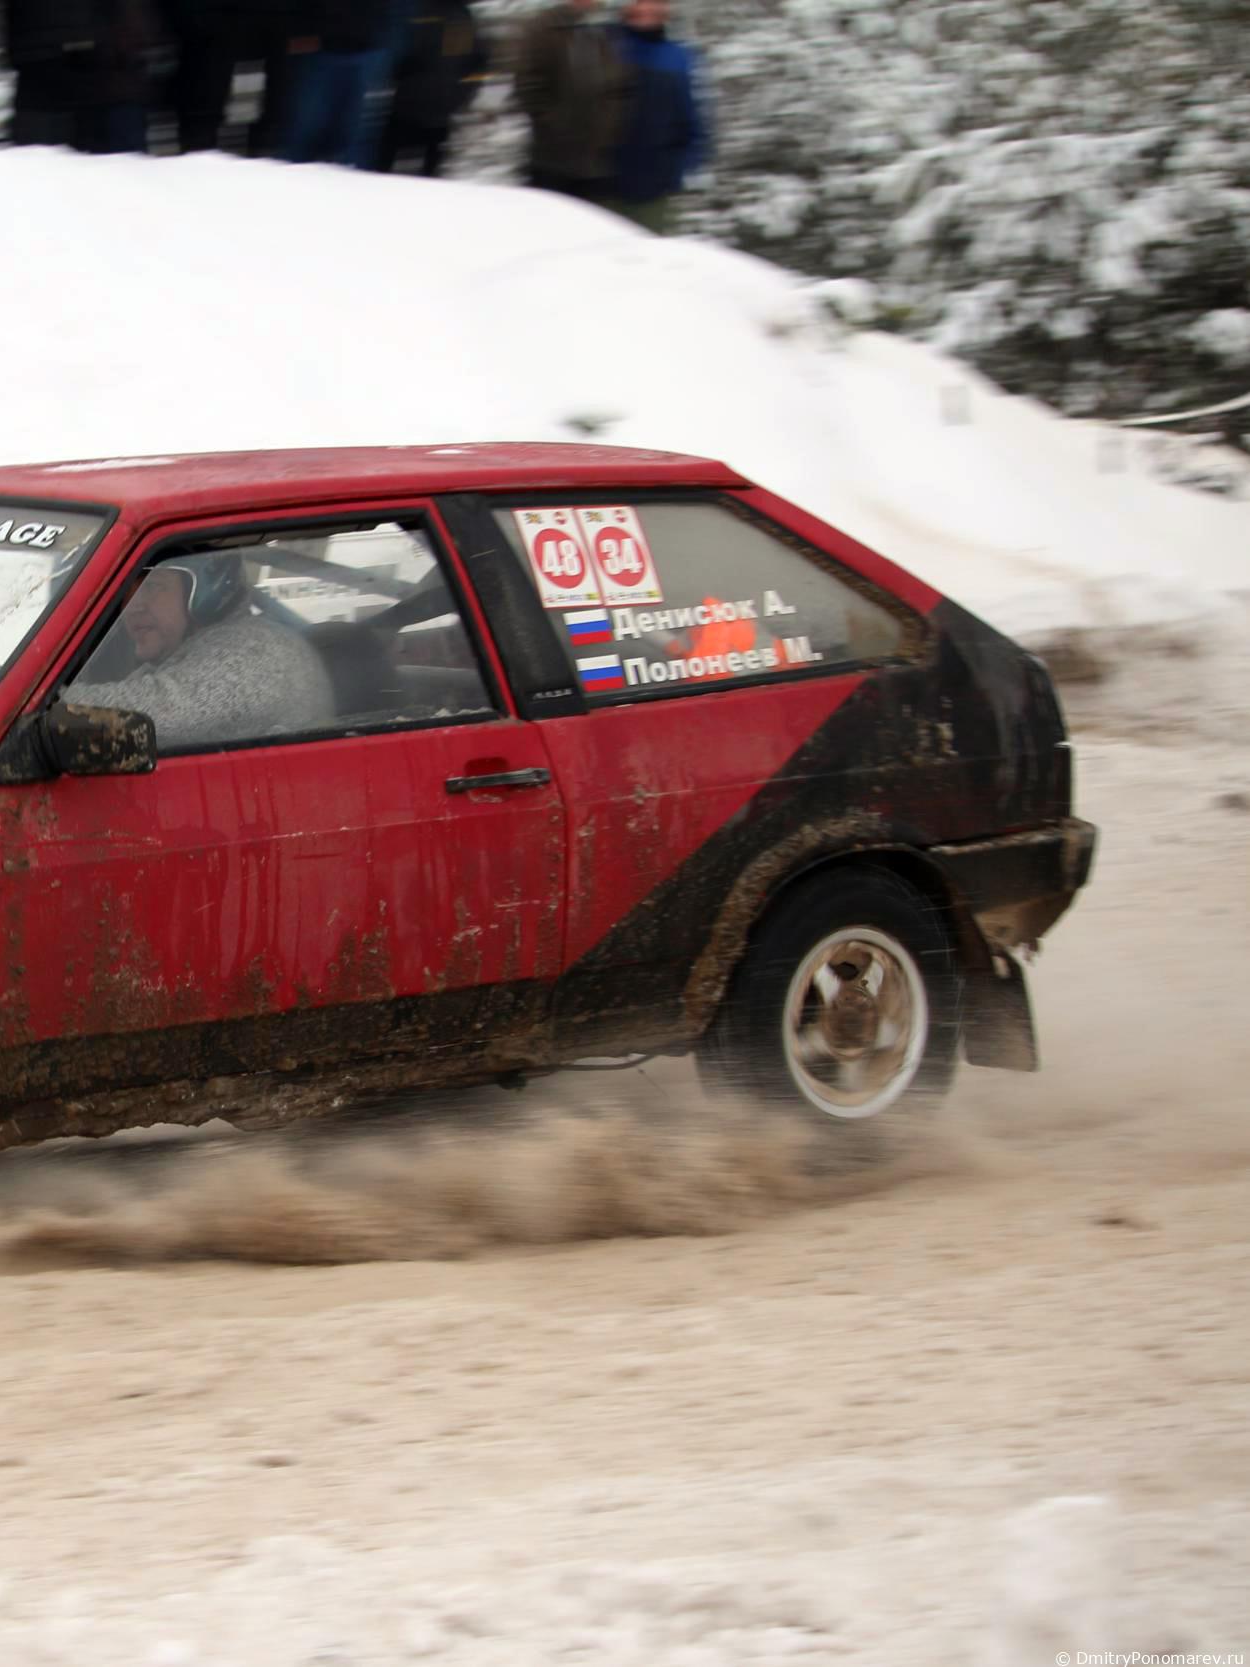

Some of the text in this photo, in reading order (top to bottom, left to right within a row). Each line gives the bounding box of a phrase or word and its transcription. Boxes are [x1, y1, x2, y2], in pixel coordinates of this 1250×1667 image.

[541, 540, 582, 577] 48
[601, 538, 643, 576] 34
[612, 590, 797, 641] Денисюк А.
